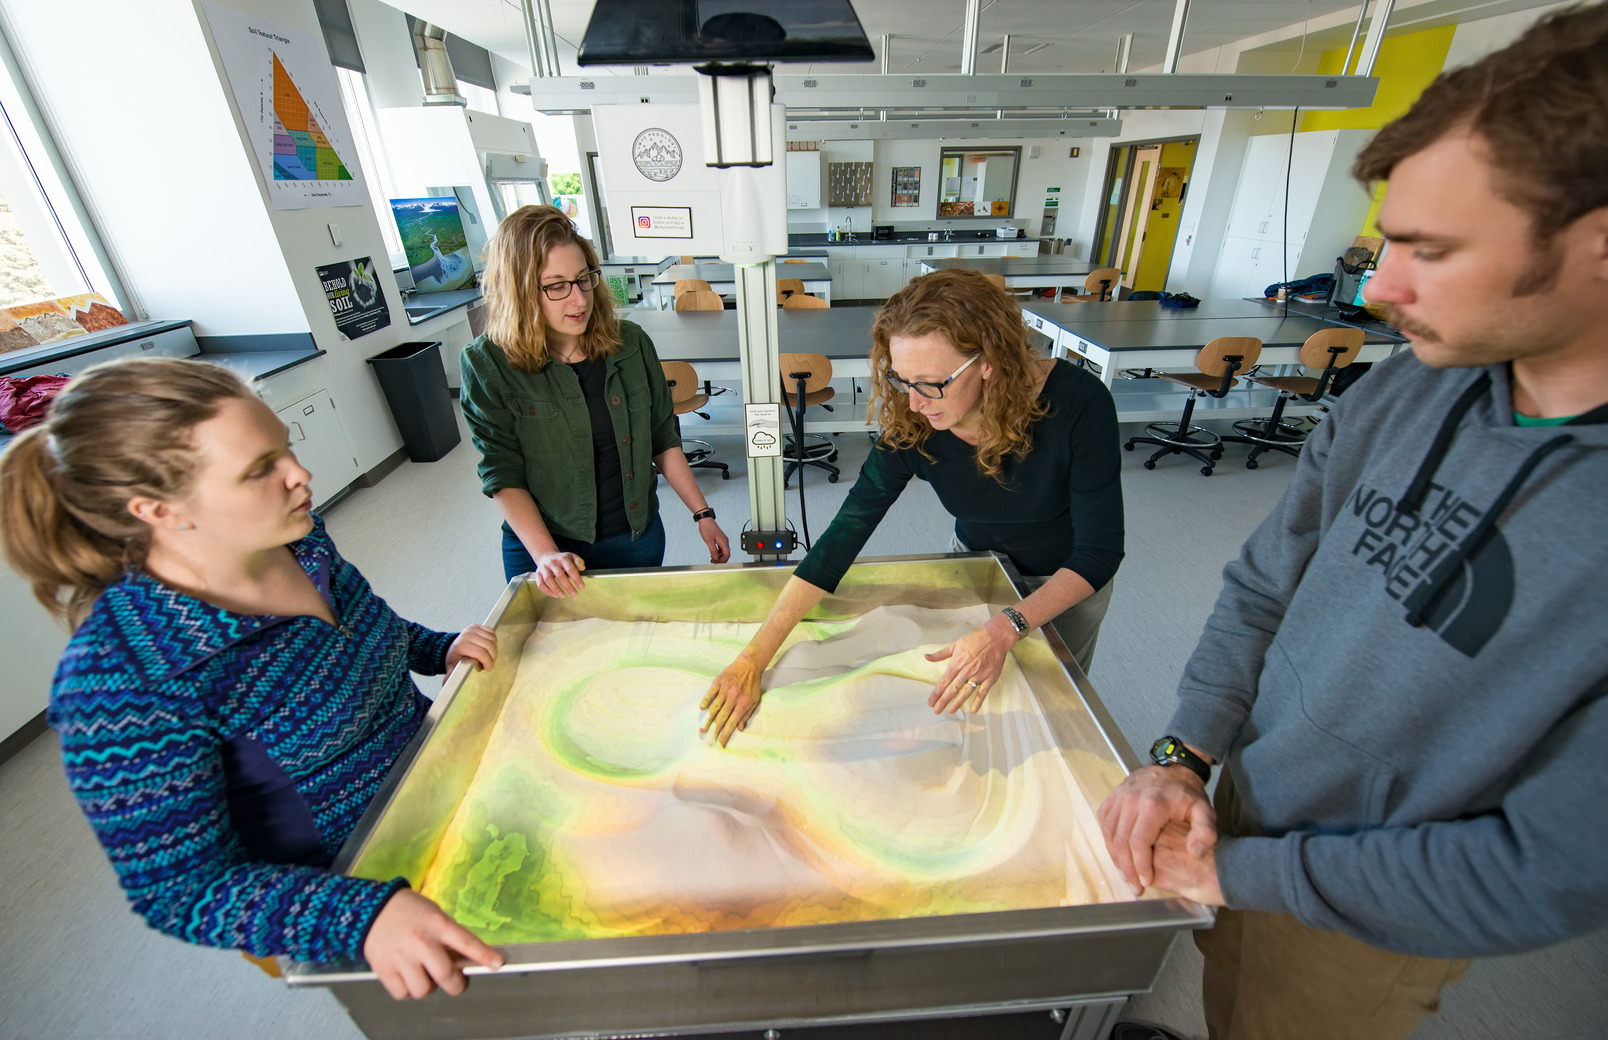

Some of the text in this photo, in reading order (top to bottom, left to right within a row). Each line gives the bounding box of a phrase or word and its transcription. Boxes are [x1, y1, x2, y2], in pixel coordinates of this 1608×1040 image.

[248, 26, 257, 35] Soil
[323, 277, 347, 292] BEHOLD
[334, 288, 350, 298] living
[330, 296, 353, 313] SOIL
